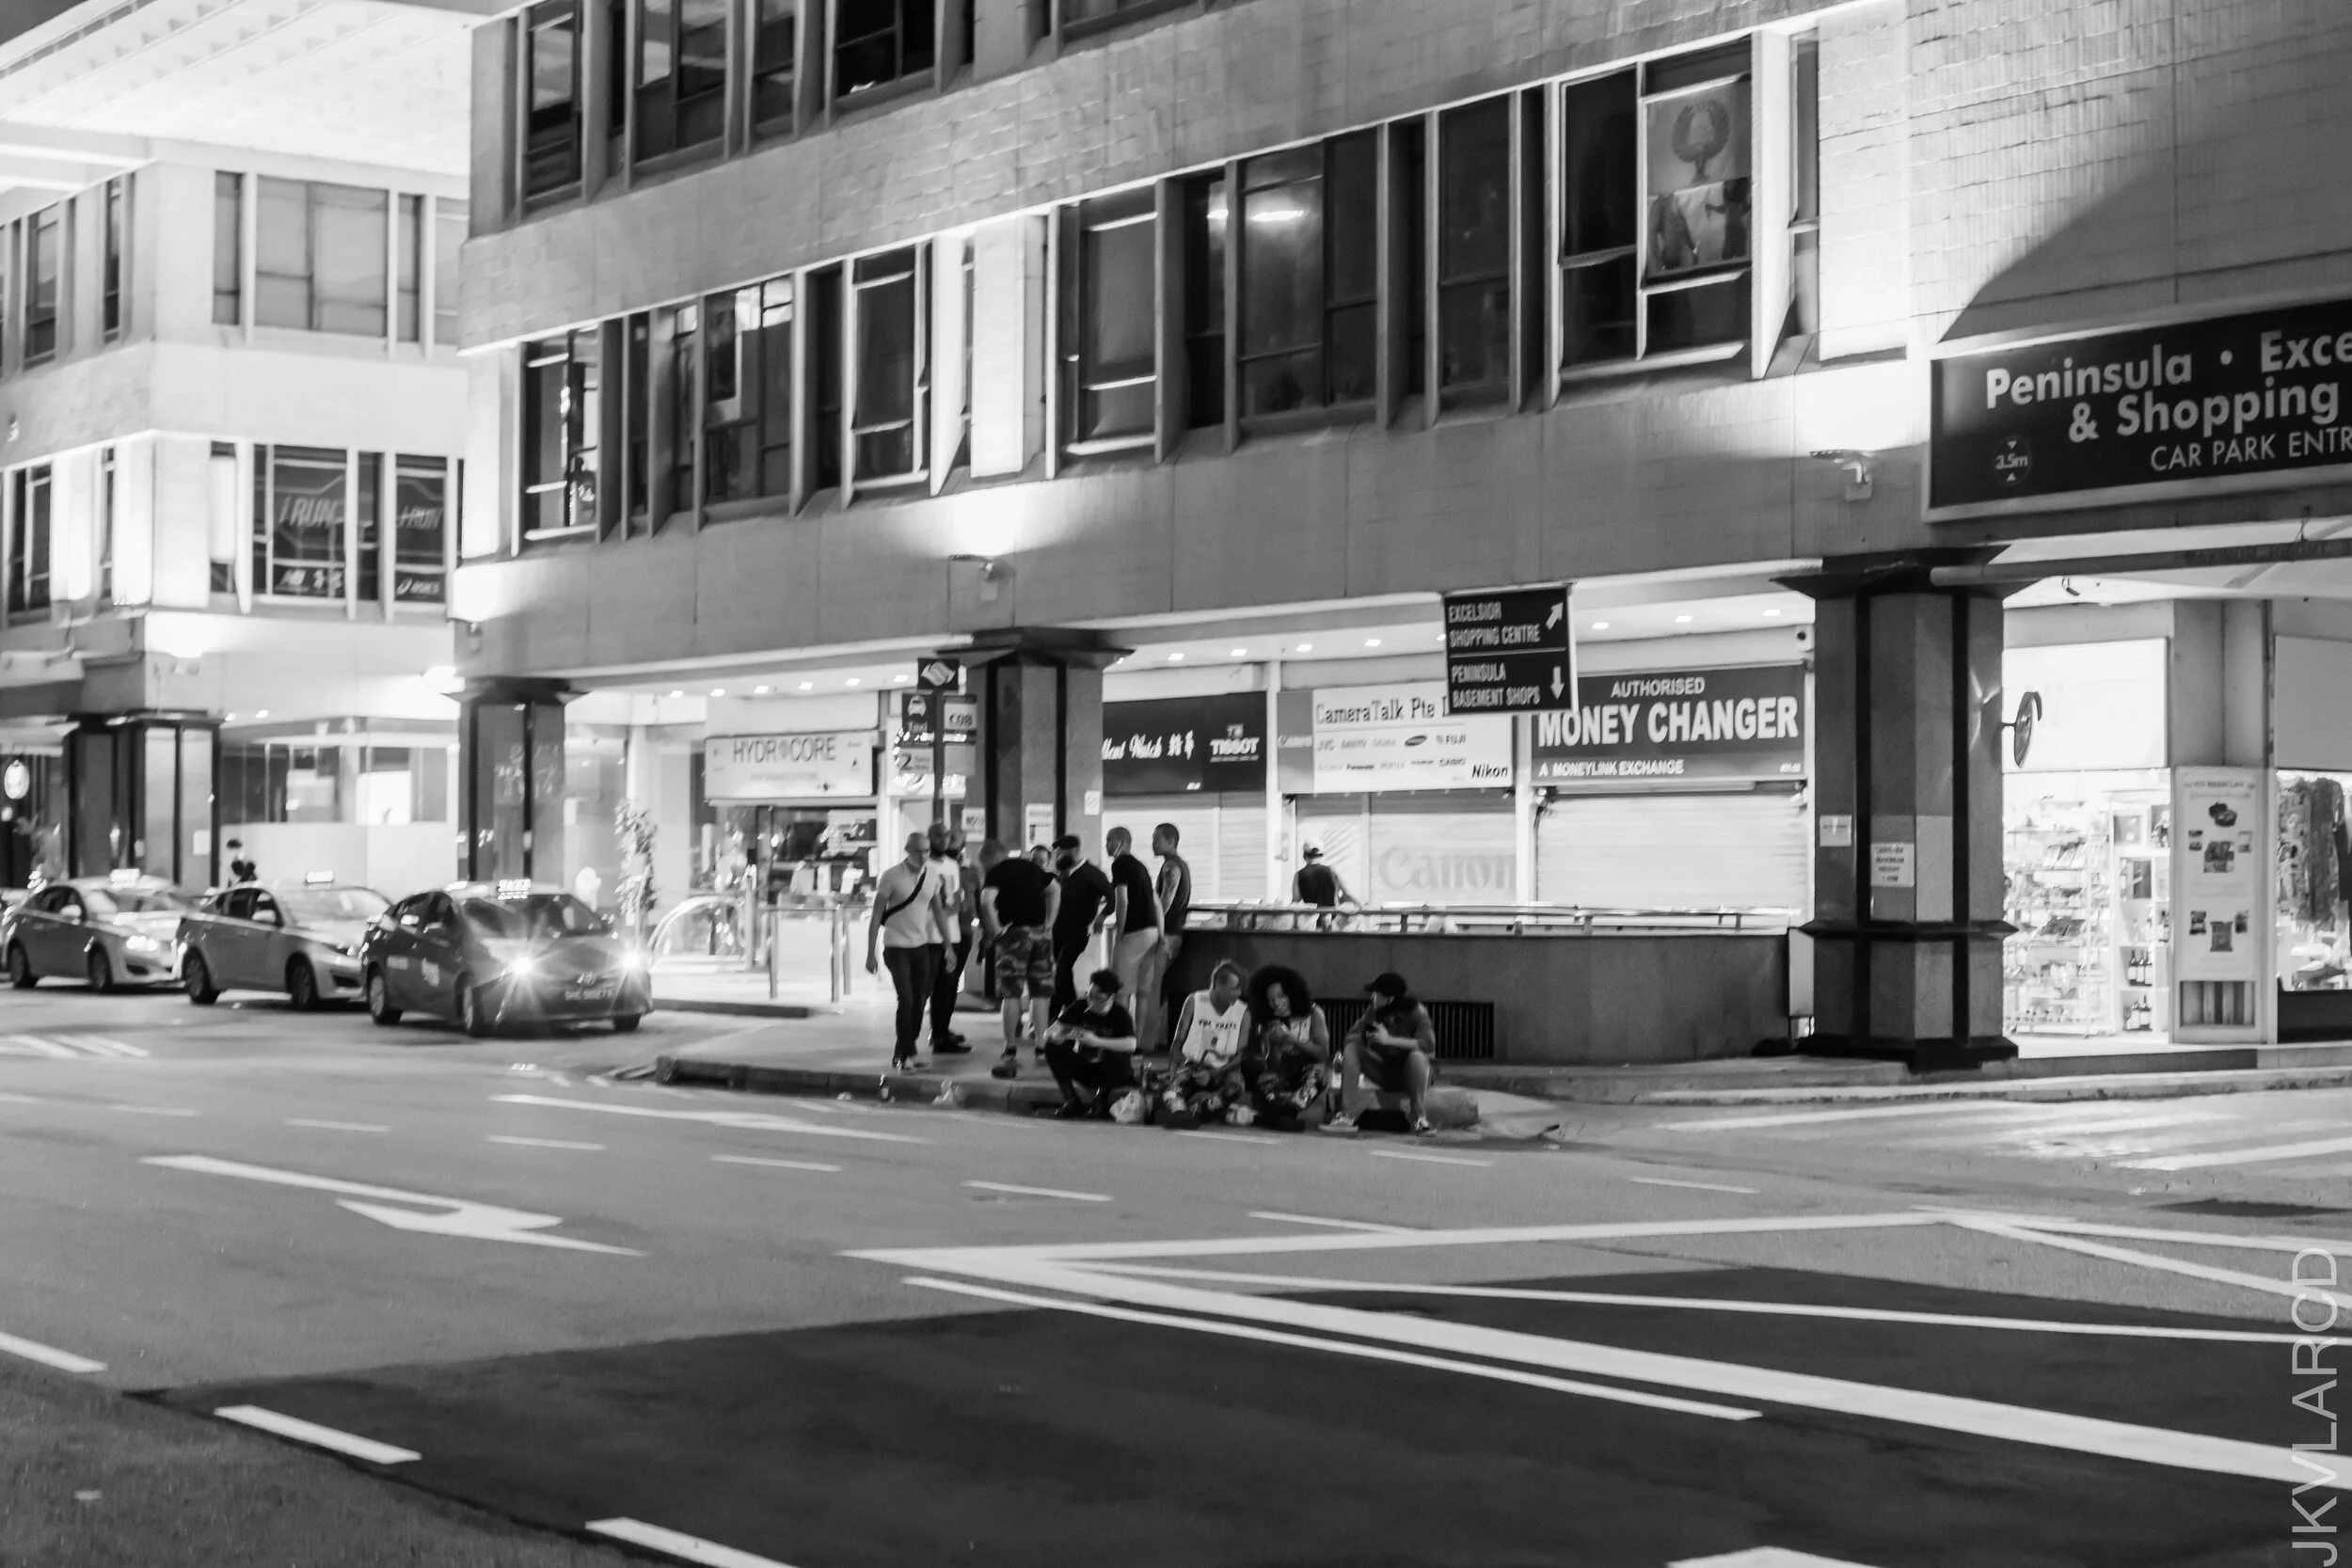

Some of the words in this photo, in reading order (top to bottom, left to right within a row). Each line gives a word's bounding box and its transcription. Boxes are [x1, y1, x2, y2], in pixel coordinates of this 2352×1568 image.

[1986, 343, 2192, 409] Peninsula
[2261, 330, 2352, 372] Exce
[2069, 402, 2099, 443] &
[2117, 376, 2339, 437] Shopping
[2151, 443, 2202, 471] CAR
[2213, 433, 2277, 466] PARK
[2288, 426, 2352, 458] ENTR
[1994, 452, 2029, 470] 3.5m
[1449, 602, 1502, 623] EXCELSIOR
[1450, 627, 1500, 648] SHOPPING
[1502, 624, 1541, 644] CENTRE
[1452, 662, 1506, 683] PENINSULA
[1453, 688, 1504, 708] BASEMENT
[1506, 686, 1541, 706] SHOPS
[1610, 676, 1706, 698] AUTHORISED
[1410, 697, 1436, 720] Pte
[1538, 704, 1641, 747] MONEY
[1647, 696, 1799, 743] CHANGER
[1210, 736, 1261, 756] TISSOT
[1471, 764, 1509, 780] Nikon
[1538, 763, 1549, 777] A
[1618, 759, 1685, 776] EXCHANGE
[1378, 845, 1518, 890] Canon
